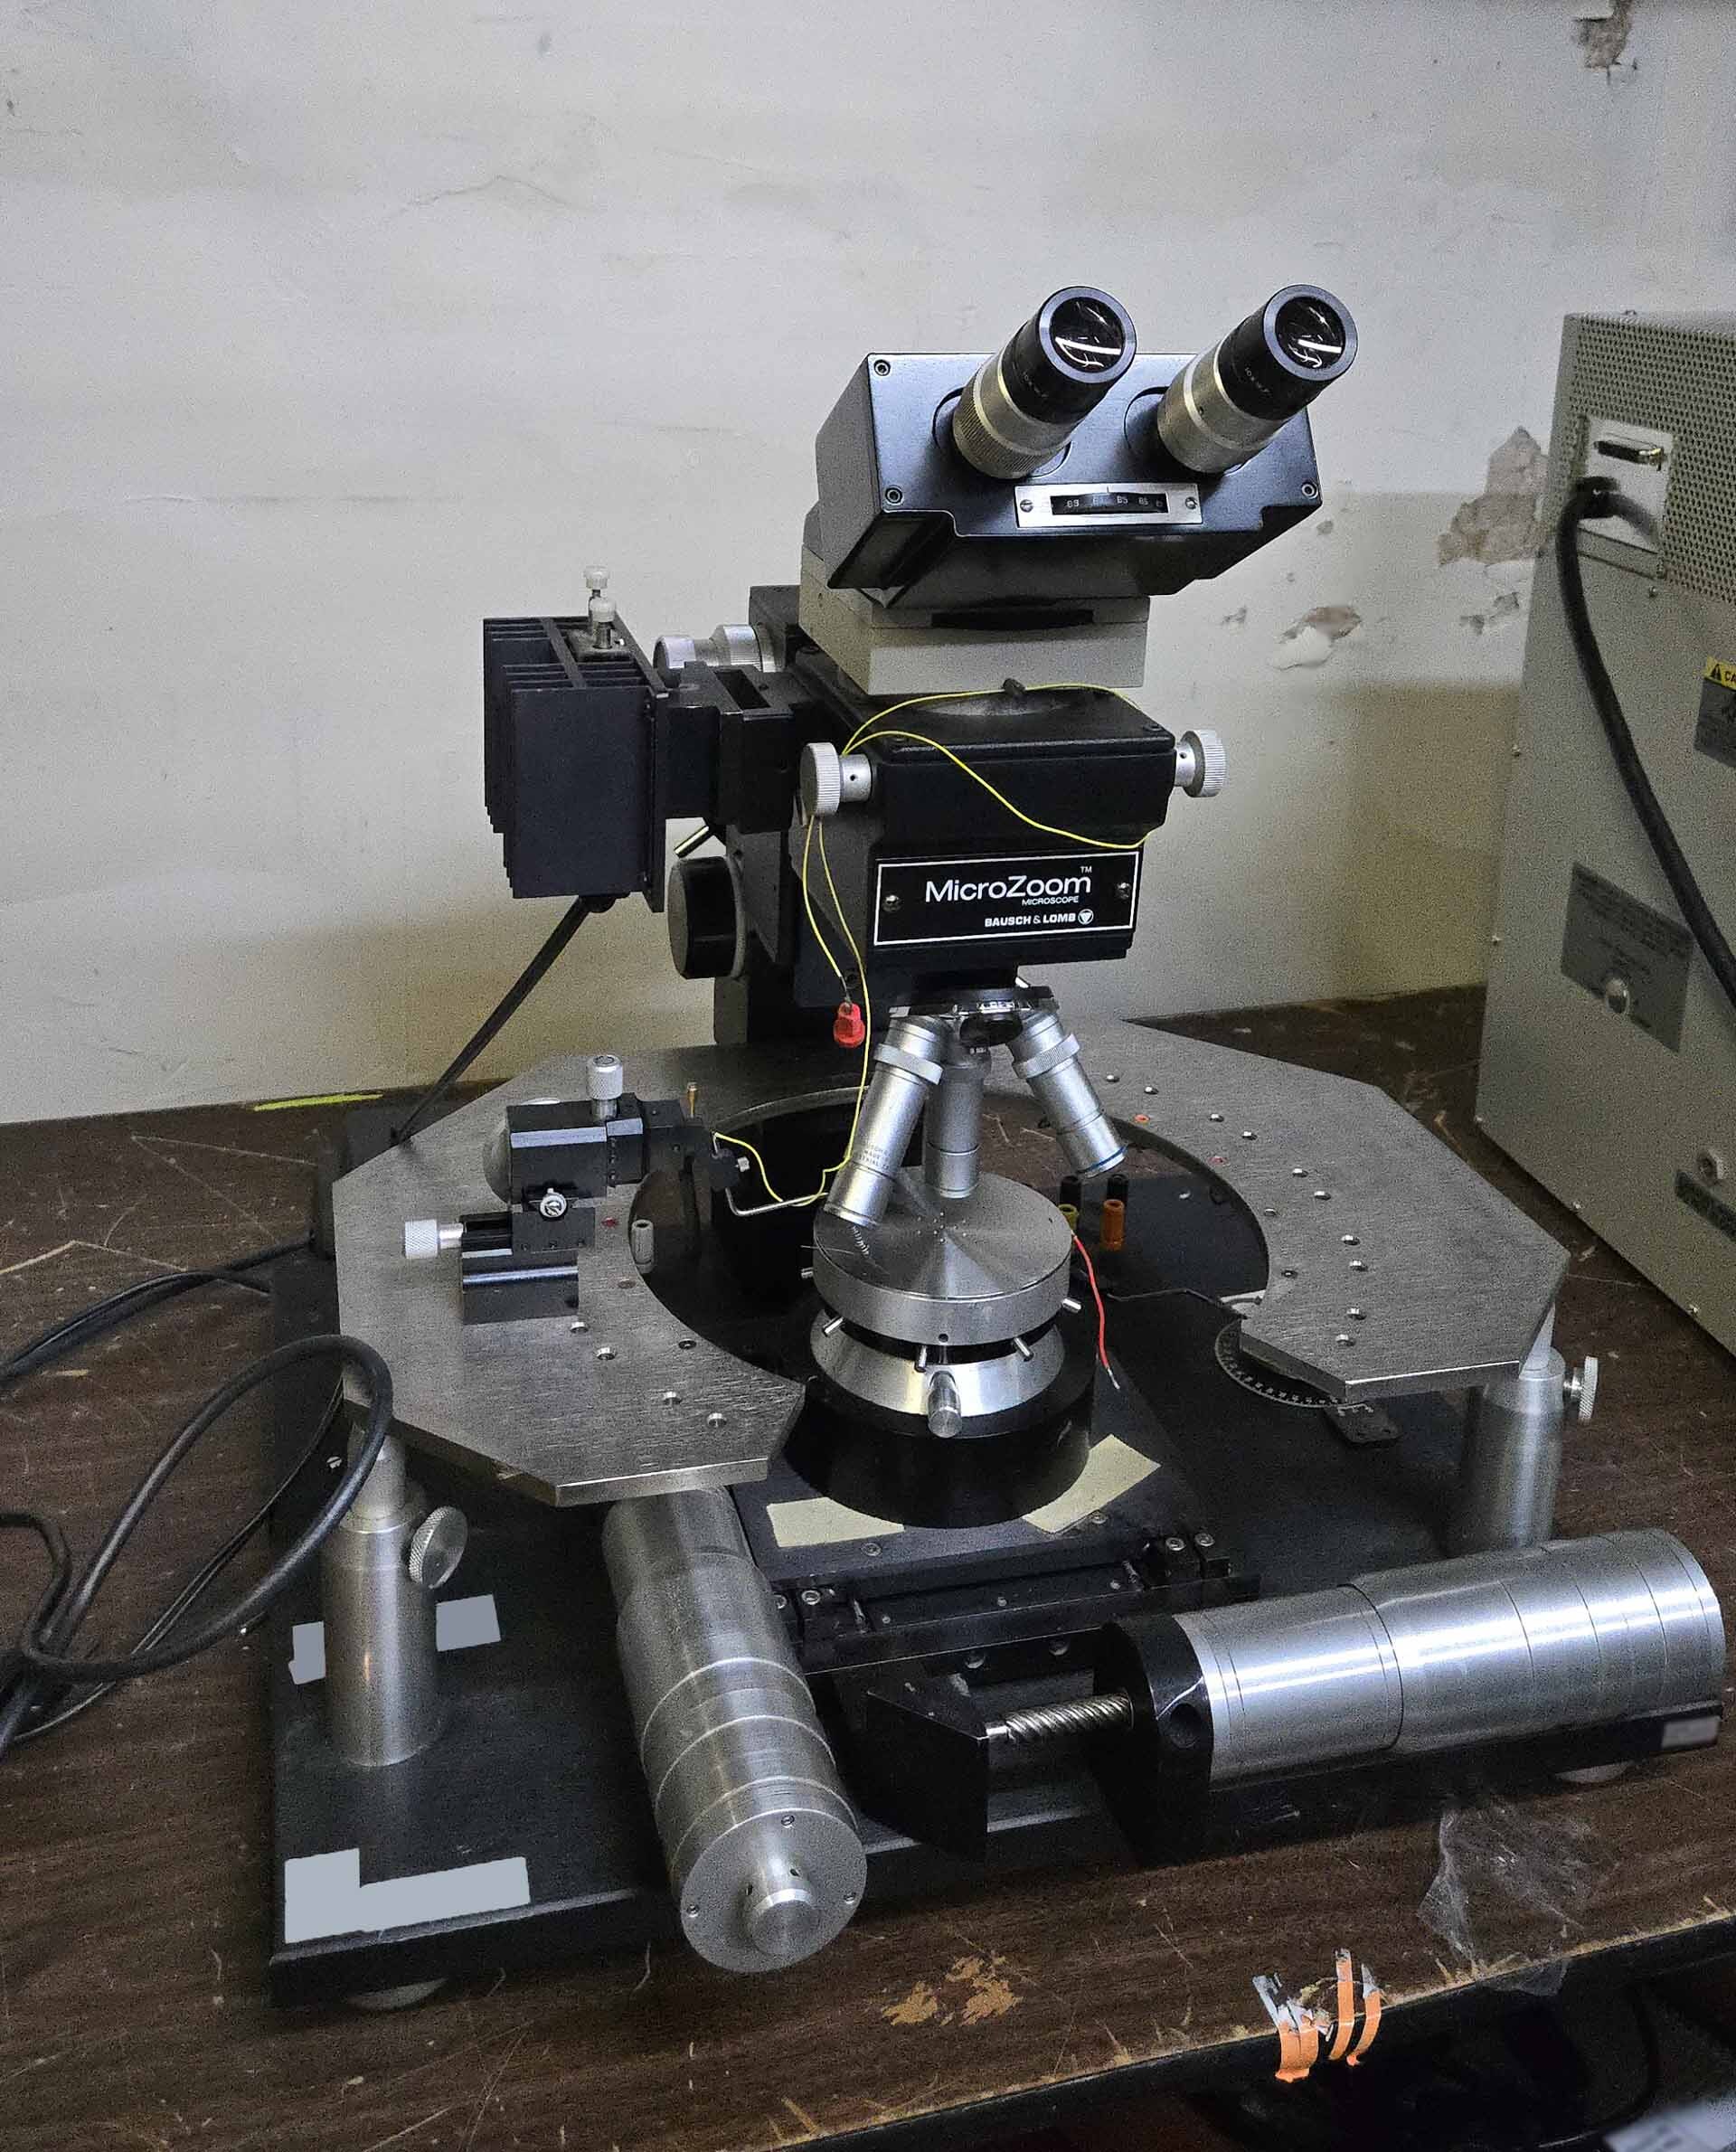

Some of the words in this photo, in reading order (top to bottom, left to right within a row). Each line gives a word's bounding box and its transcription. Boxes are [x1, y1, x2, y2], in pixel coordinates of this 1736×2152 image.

[1080, 865, 1092, 873] TM
[925, 875, 1091, 902] MicroZoom
[1022, 895, 1079, 906] MICROSCOPE
[984, 916, 1032, 928] BAUSCH
[1033, 914, 1042, 924] &
[1043, 912, 1076, 924] LOMB
